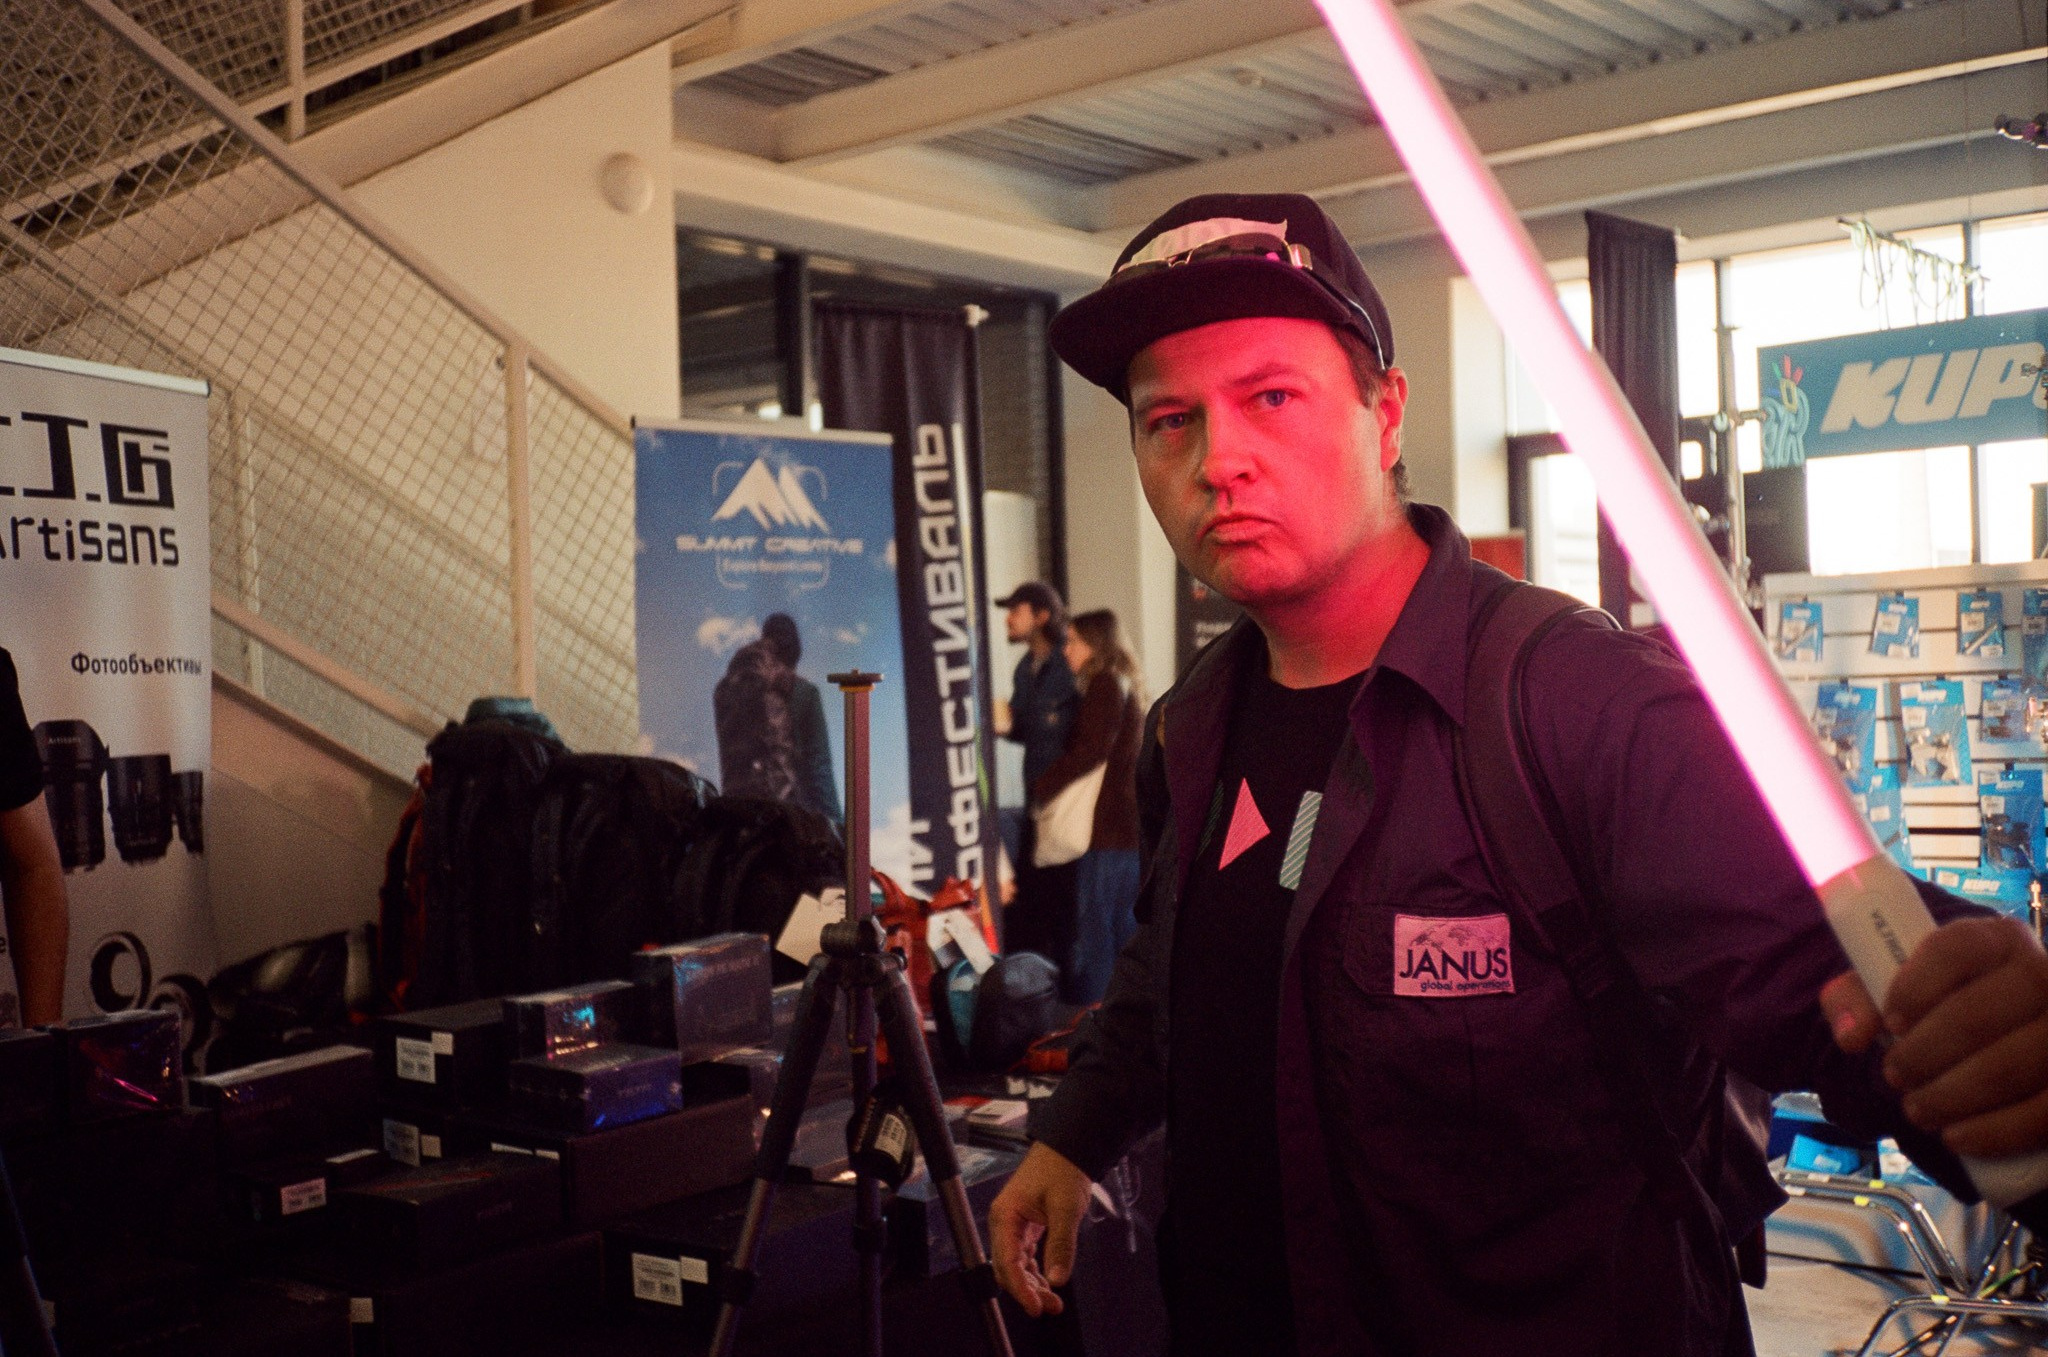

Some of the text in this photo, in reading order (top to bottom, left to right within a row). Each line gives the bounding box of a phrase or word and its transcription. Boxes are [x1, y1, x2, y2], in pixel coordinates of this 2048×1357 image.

[0, 516, 179, 566] rtisans
[1399, 947, 1508, 981] JANUS
[1420, 980, 1453, 993] global
